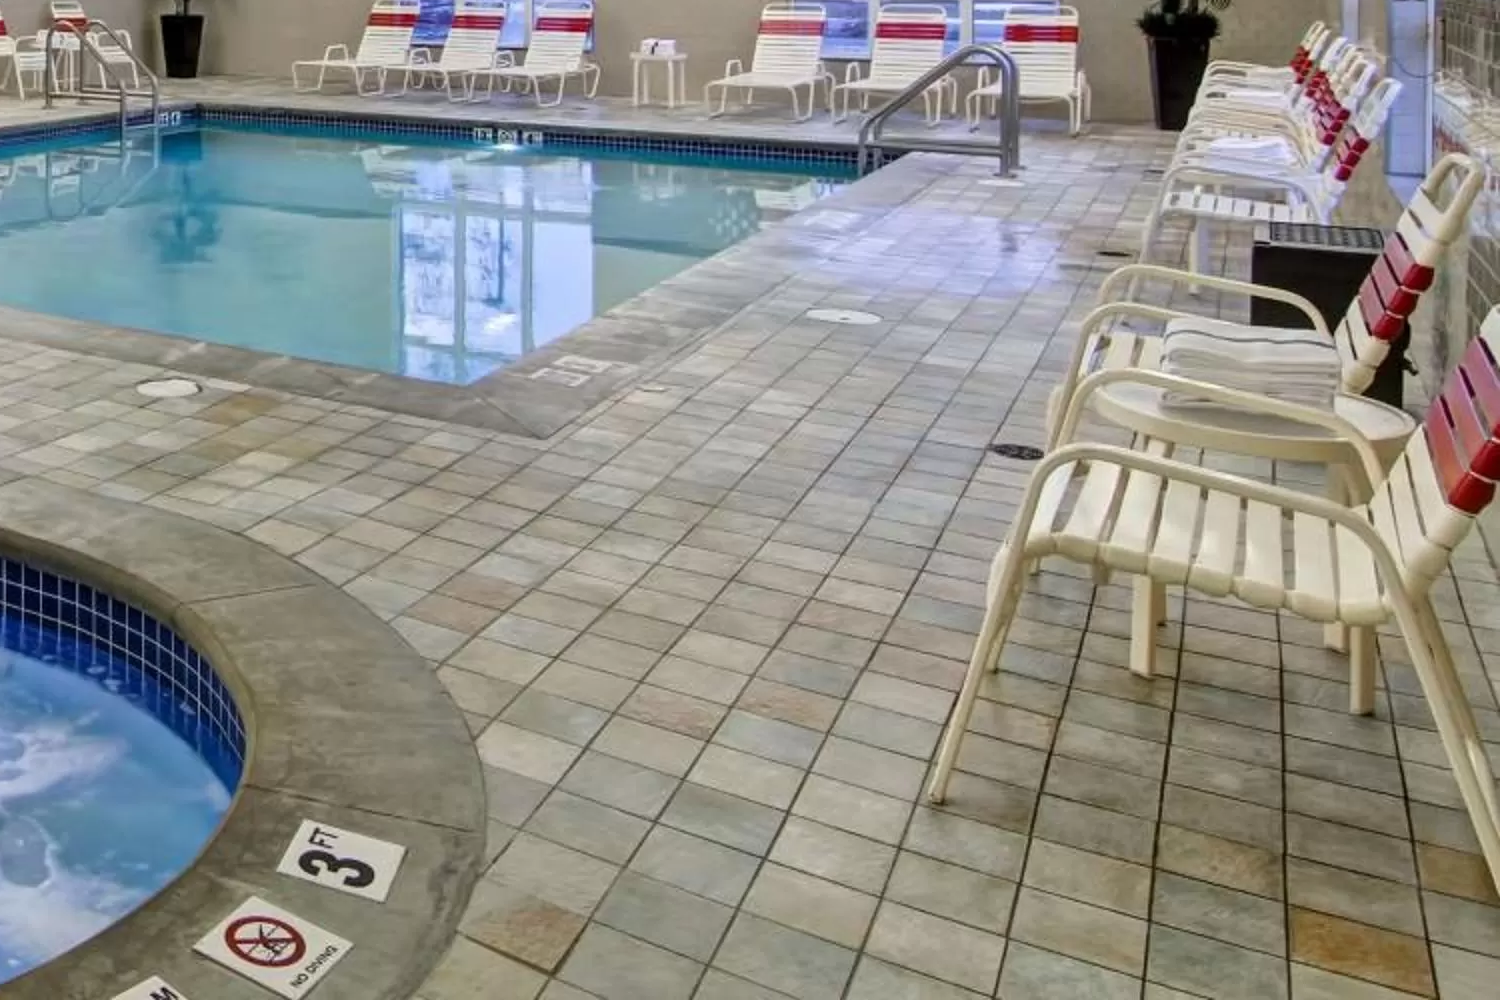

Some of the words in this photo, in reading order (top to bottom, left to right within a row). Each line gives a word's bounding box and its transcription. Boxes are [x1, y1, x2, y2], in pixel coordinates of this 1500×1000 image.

[307, 827, 340, 849] FT
[298, 849, 377, 889] 3
[290, 973, 309, 988] NO
[305, 945, 338, 974] DIVING
